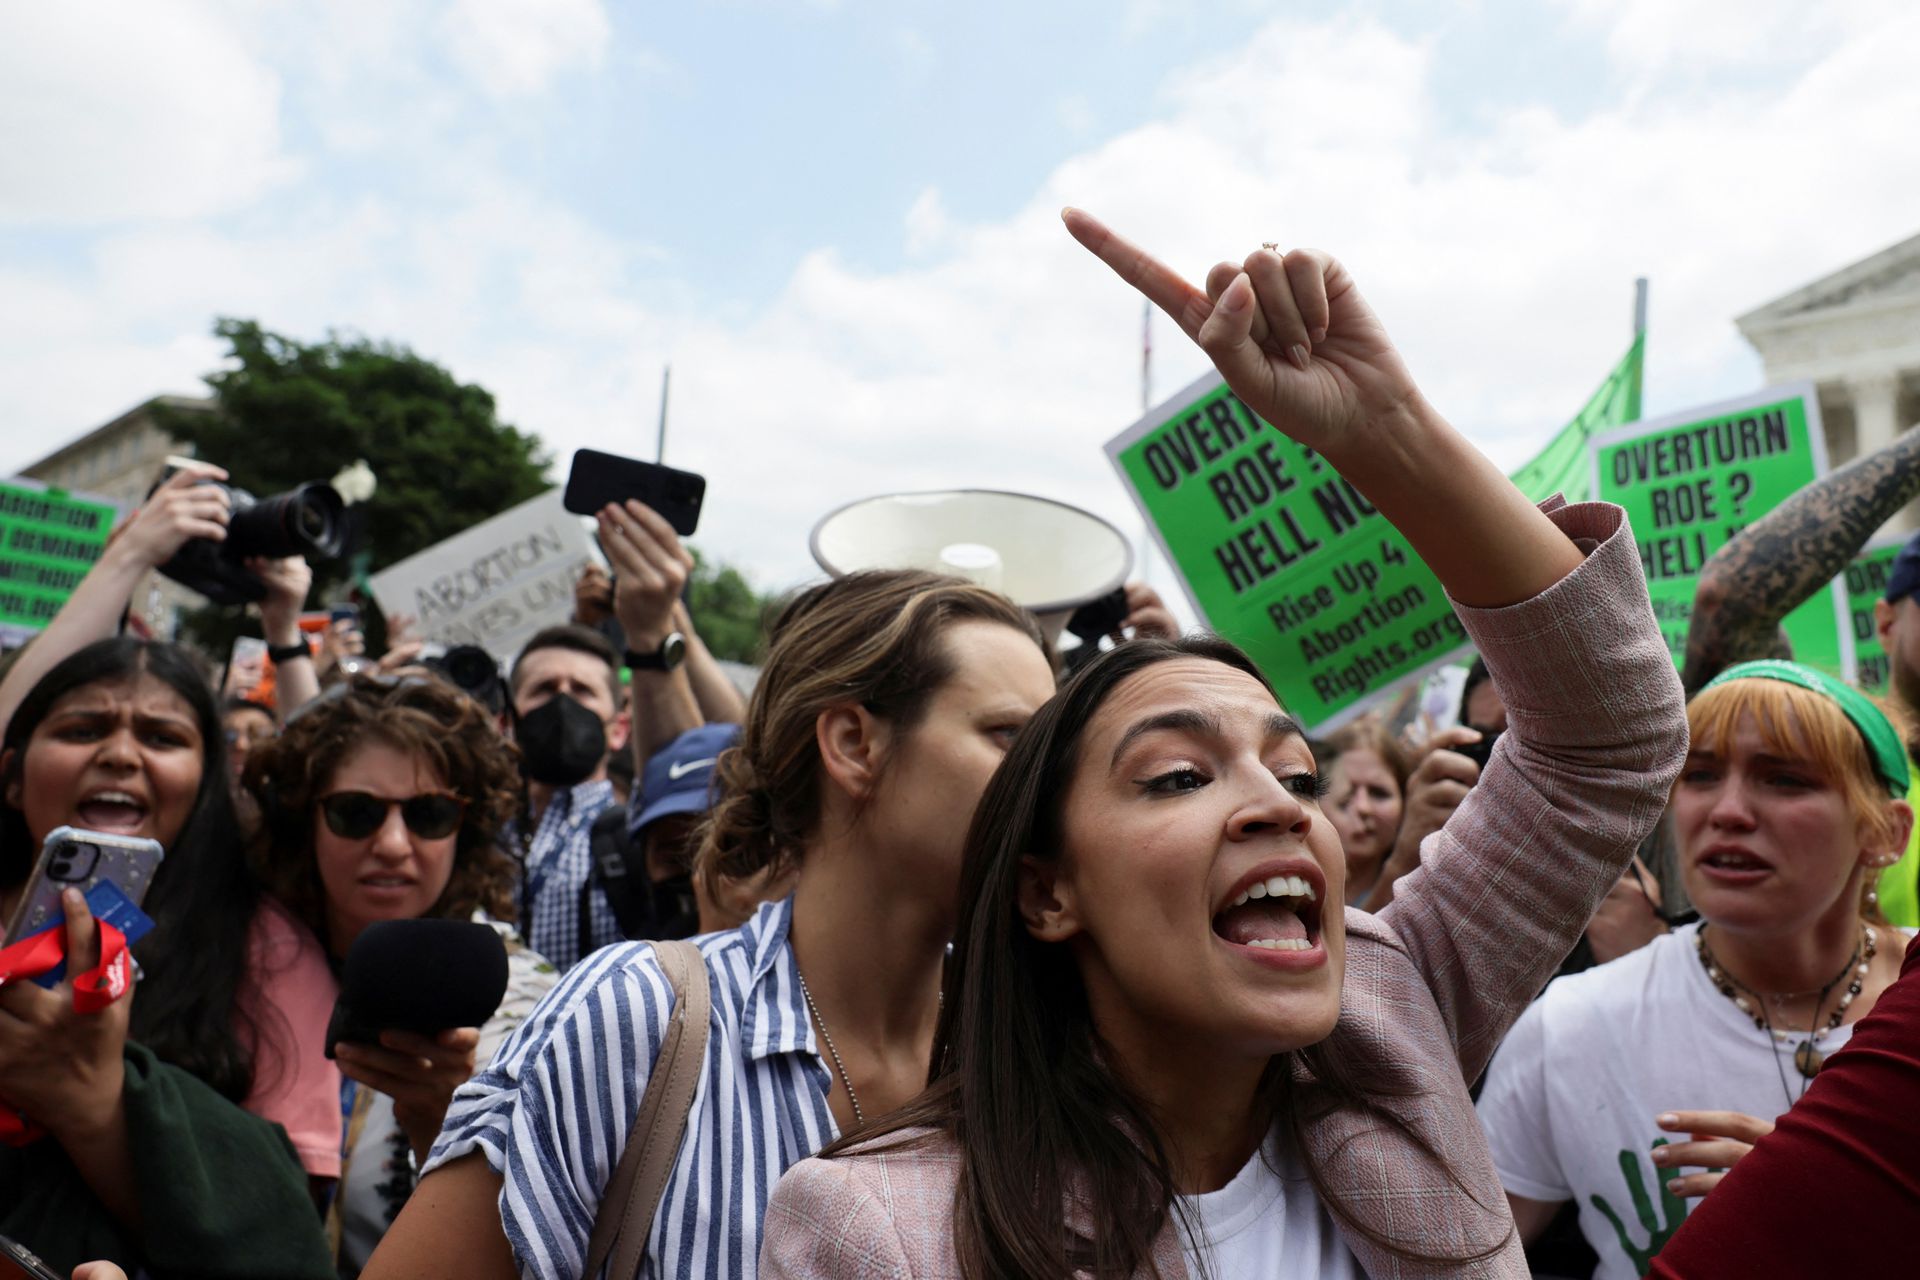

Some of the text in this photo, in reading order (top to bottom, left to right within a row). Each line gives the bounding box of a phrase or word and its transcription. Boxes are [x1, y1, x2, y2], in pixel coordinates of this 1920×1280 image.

[1143, 388, 1262, 491] OVERT
[1209, 441, 1296, 523] ROE
[1614, 408, 1788, 486] OVERTURN
[1652, 472, 1751, 529] ROE ?
[413, 522, 565, 622] ABORTION
[1214, 507, 1320, 595] HELL
[1268, 540, 1406, 634] Rise Up 4
[1299, 583, 1426, 664] Abortion
[1312, 611, 1468, 706] Rights.org
